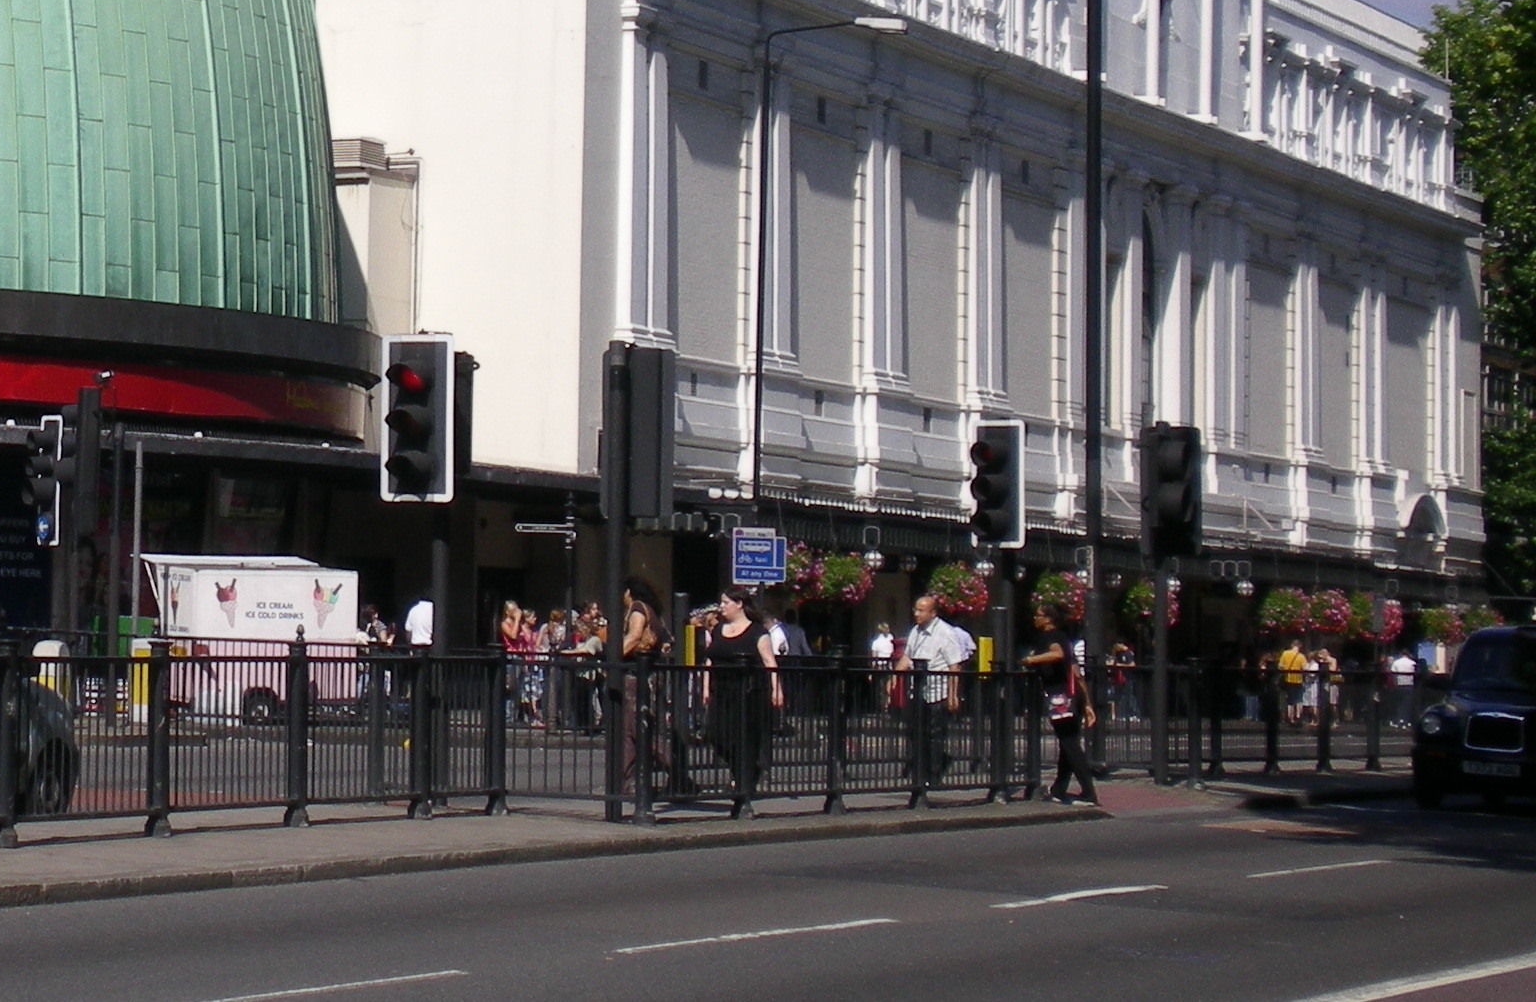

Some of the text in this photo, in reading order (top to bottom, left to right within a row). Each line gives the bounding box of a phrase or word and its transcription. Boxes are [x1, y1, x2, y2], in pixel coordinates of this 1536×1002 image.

[16, 551, 34, 560] FOR
[0, 567, 17, 577] EYE
[19, 568, 42, 578] HERE
[269, 602, 293, 610] CREAM
[257, 611, 276, 619] COLD
